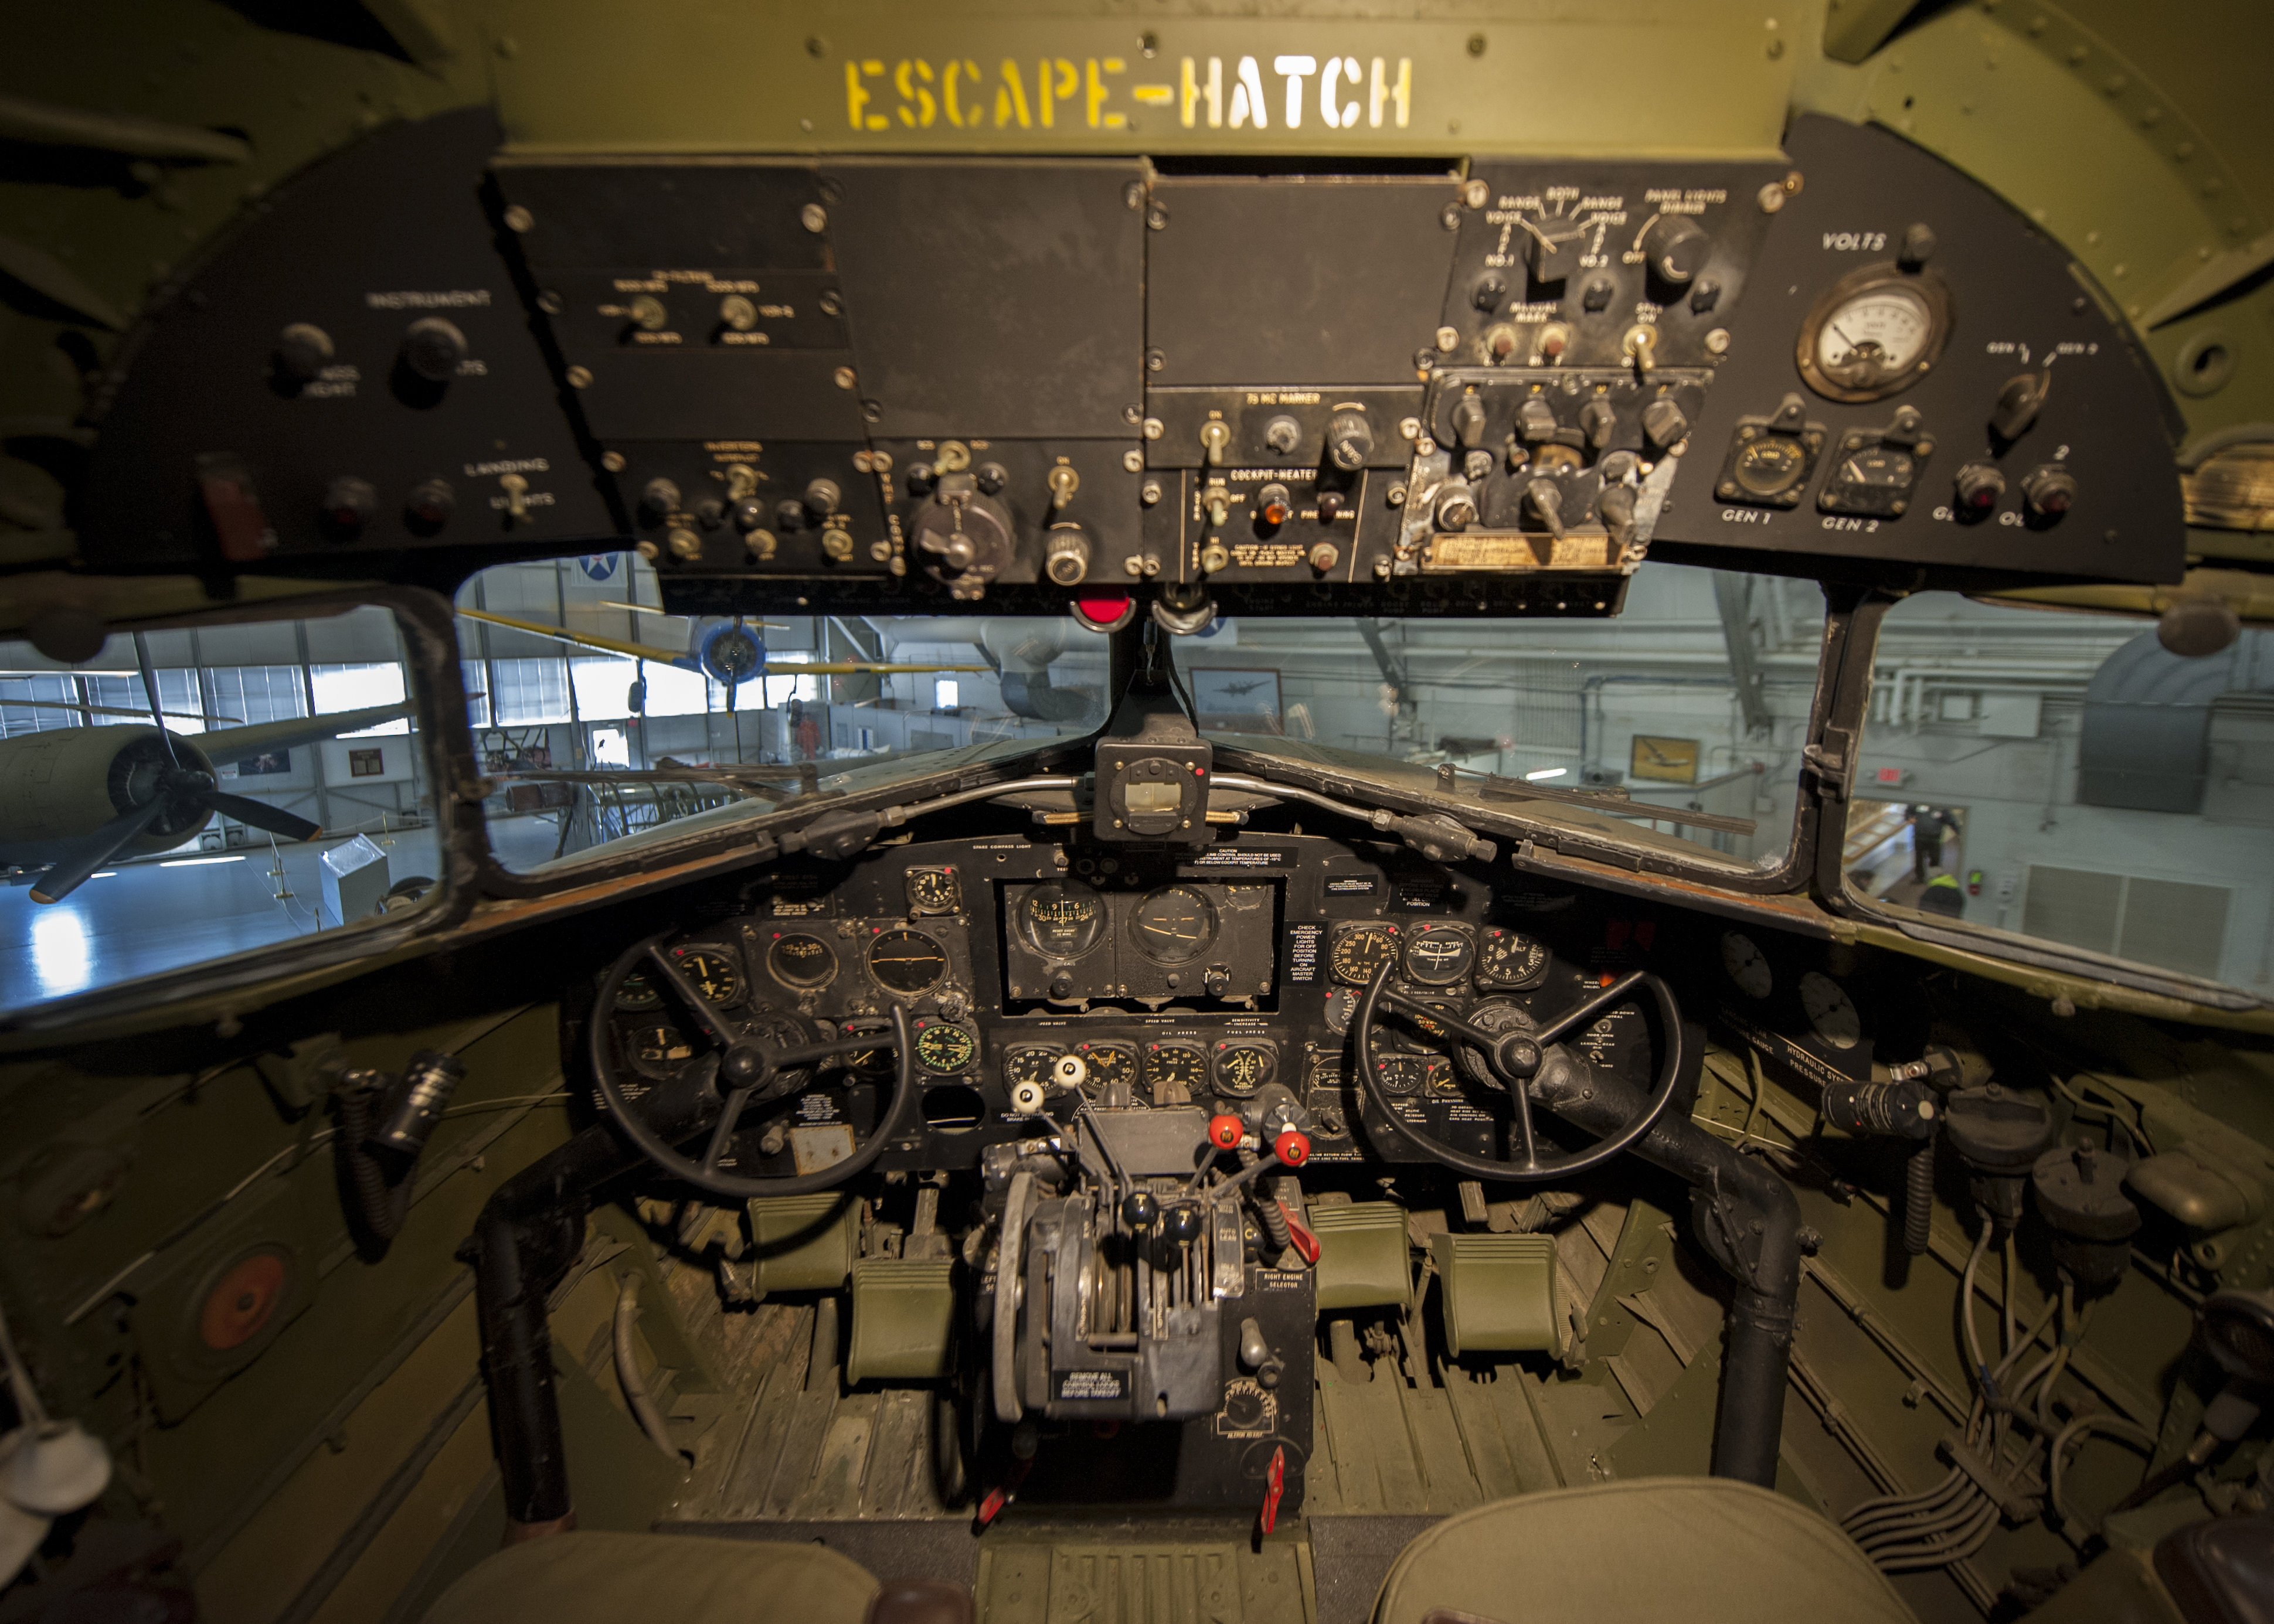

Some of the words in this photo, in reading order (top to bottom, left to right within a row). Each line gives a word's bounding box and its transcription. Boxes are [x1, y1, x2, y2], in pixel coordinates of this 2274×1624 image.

[1546, 186, 1579, 200] BOTH
[1486, 211, 1522, 224] VOICE
[1590, 212, 1627, 225] VOICE
[1823, 232, 1886, 251] VOLTS
[1986, 342, 2015, 354] GEN
[2056, 342, 2085, 354] GEN
[1246, 393, 1259, 405] 75
[1260, 393, 1277, 405] MC
[1279, 393, 1320, 405] MARKER
[1209, 410, 1222, 420] ON
[1056, 456, 1070, 465] ON
[464, 458, 549, 476] LANDING
[1209, 477, 1226, 486] RUN
[1230, 494, 1246, 503] OFF
[1300, 510, 1318, 519] FIRE
[1722, 509, 1758, 523] GEN
[1762, 512, 1772, 525] 1
[1821, 517, 1862, 531] GEN
[1865, 520, 1879, 533] 2
[1787, 1044, 1825, 1074] HYDRAULIC
[1221, 1131, 1233, 1143] M
[1289, 1148, 1300, 1159] M
[1135, 1193, 1147, 1204] T
[1179, 1210, 1190, 1220] T
[1245, 1228, 1253, 1240] C
